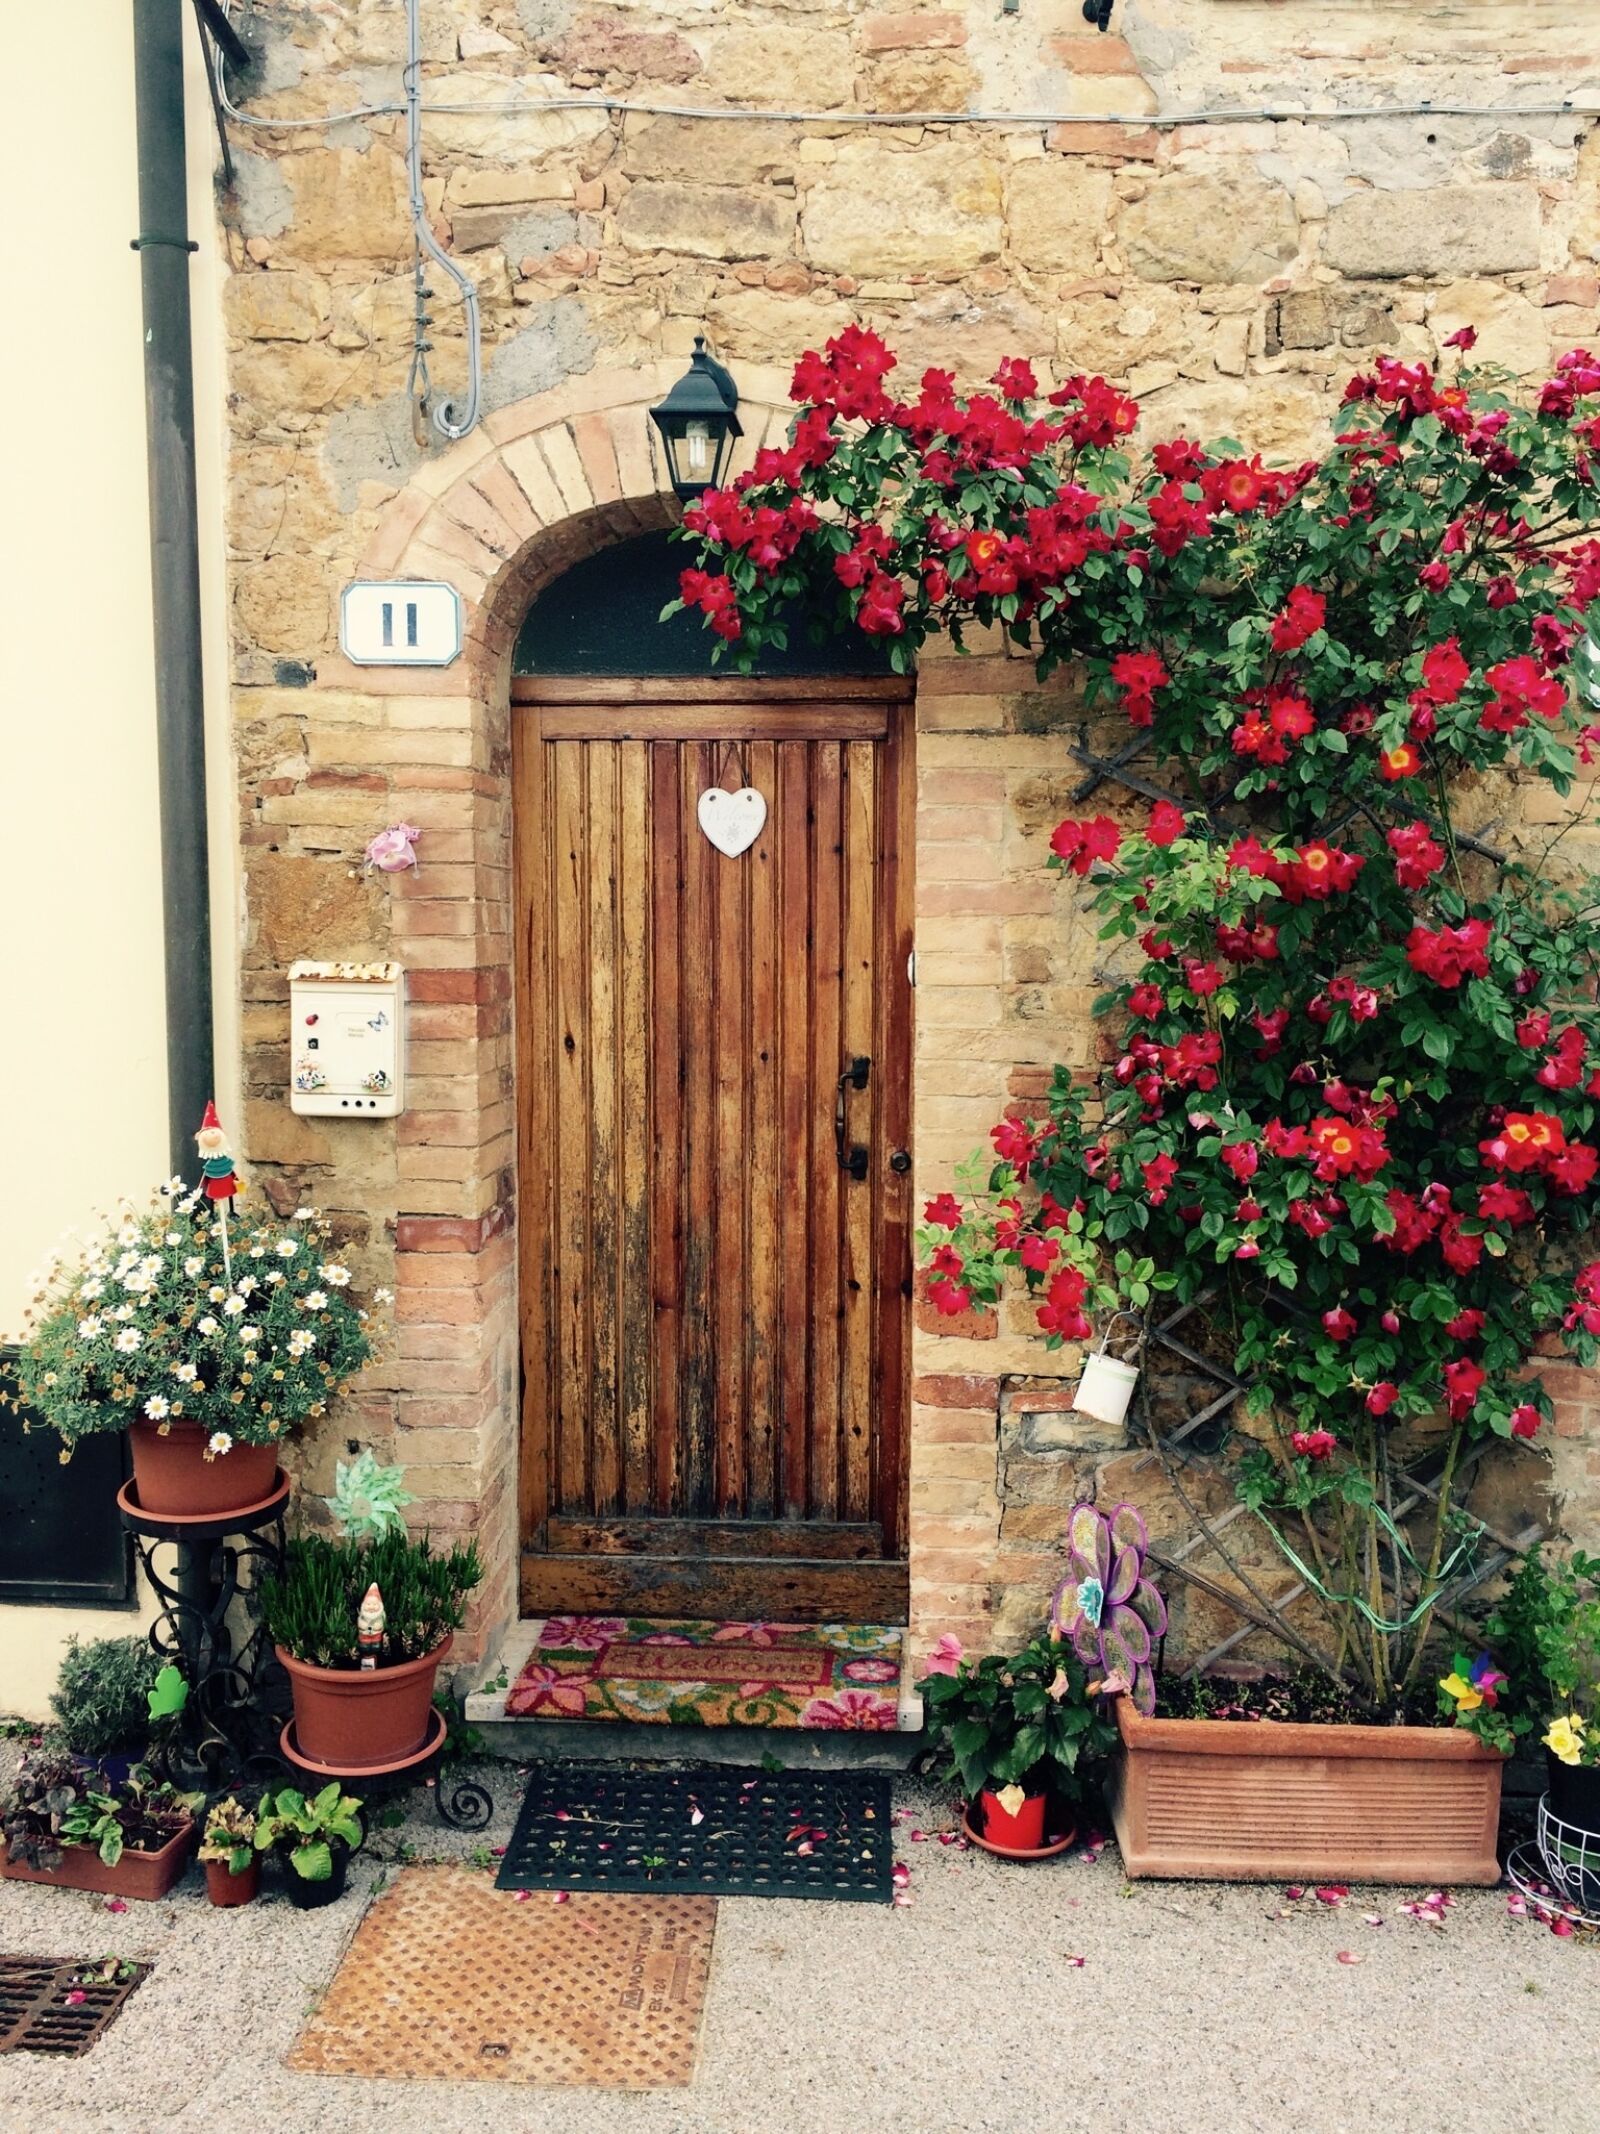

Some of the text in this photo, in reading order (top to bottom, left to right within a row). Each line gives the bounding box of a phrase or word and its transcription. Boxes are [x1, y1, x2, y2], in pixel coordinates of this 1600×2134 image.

[381, 602, 418, 647] 11
[609, 1651, 817, 1676] Welcome
[652, 1978, 667, 1995] 124
